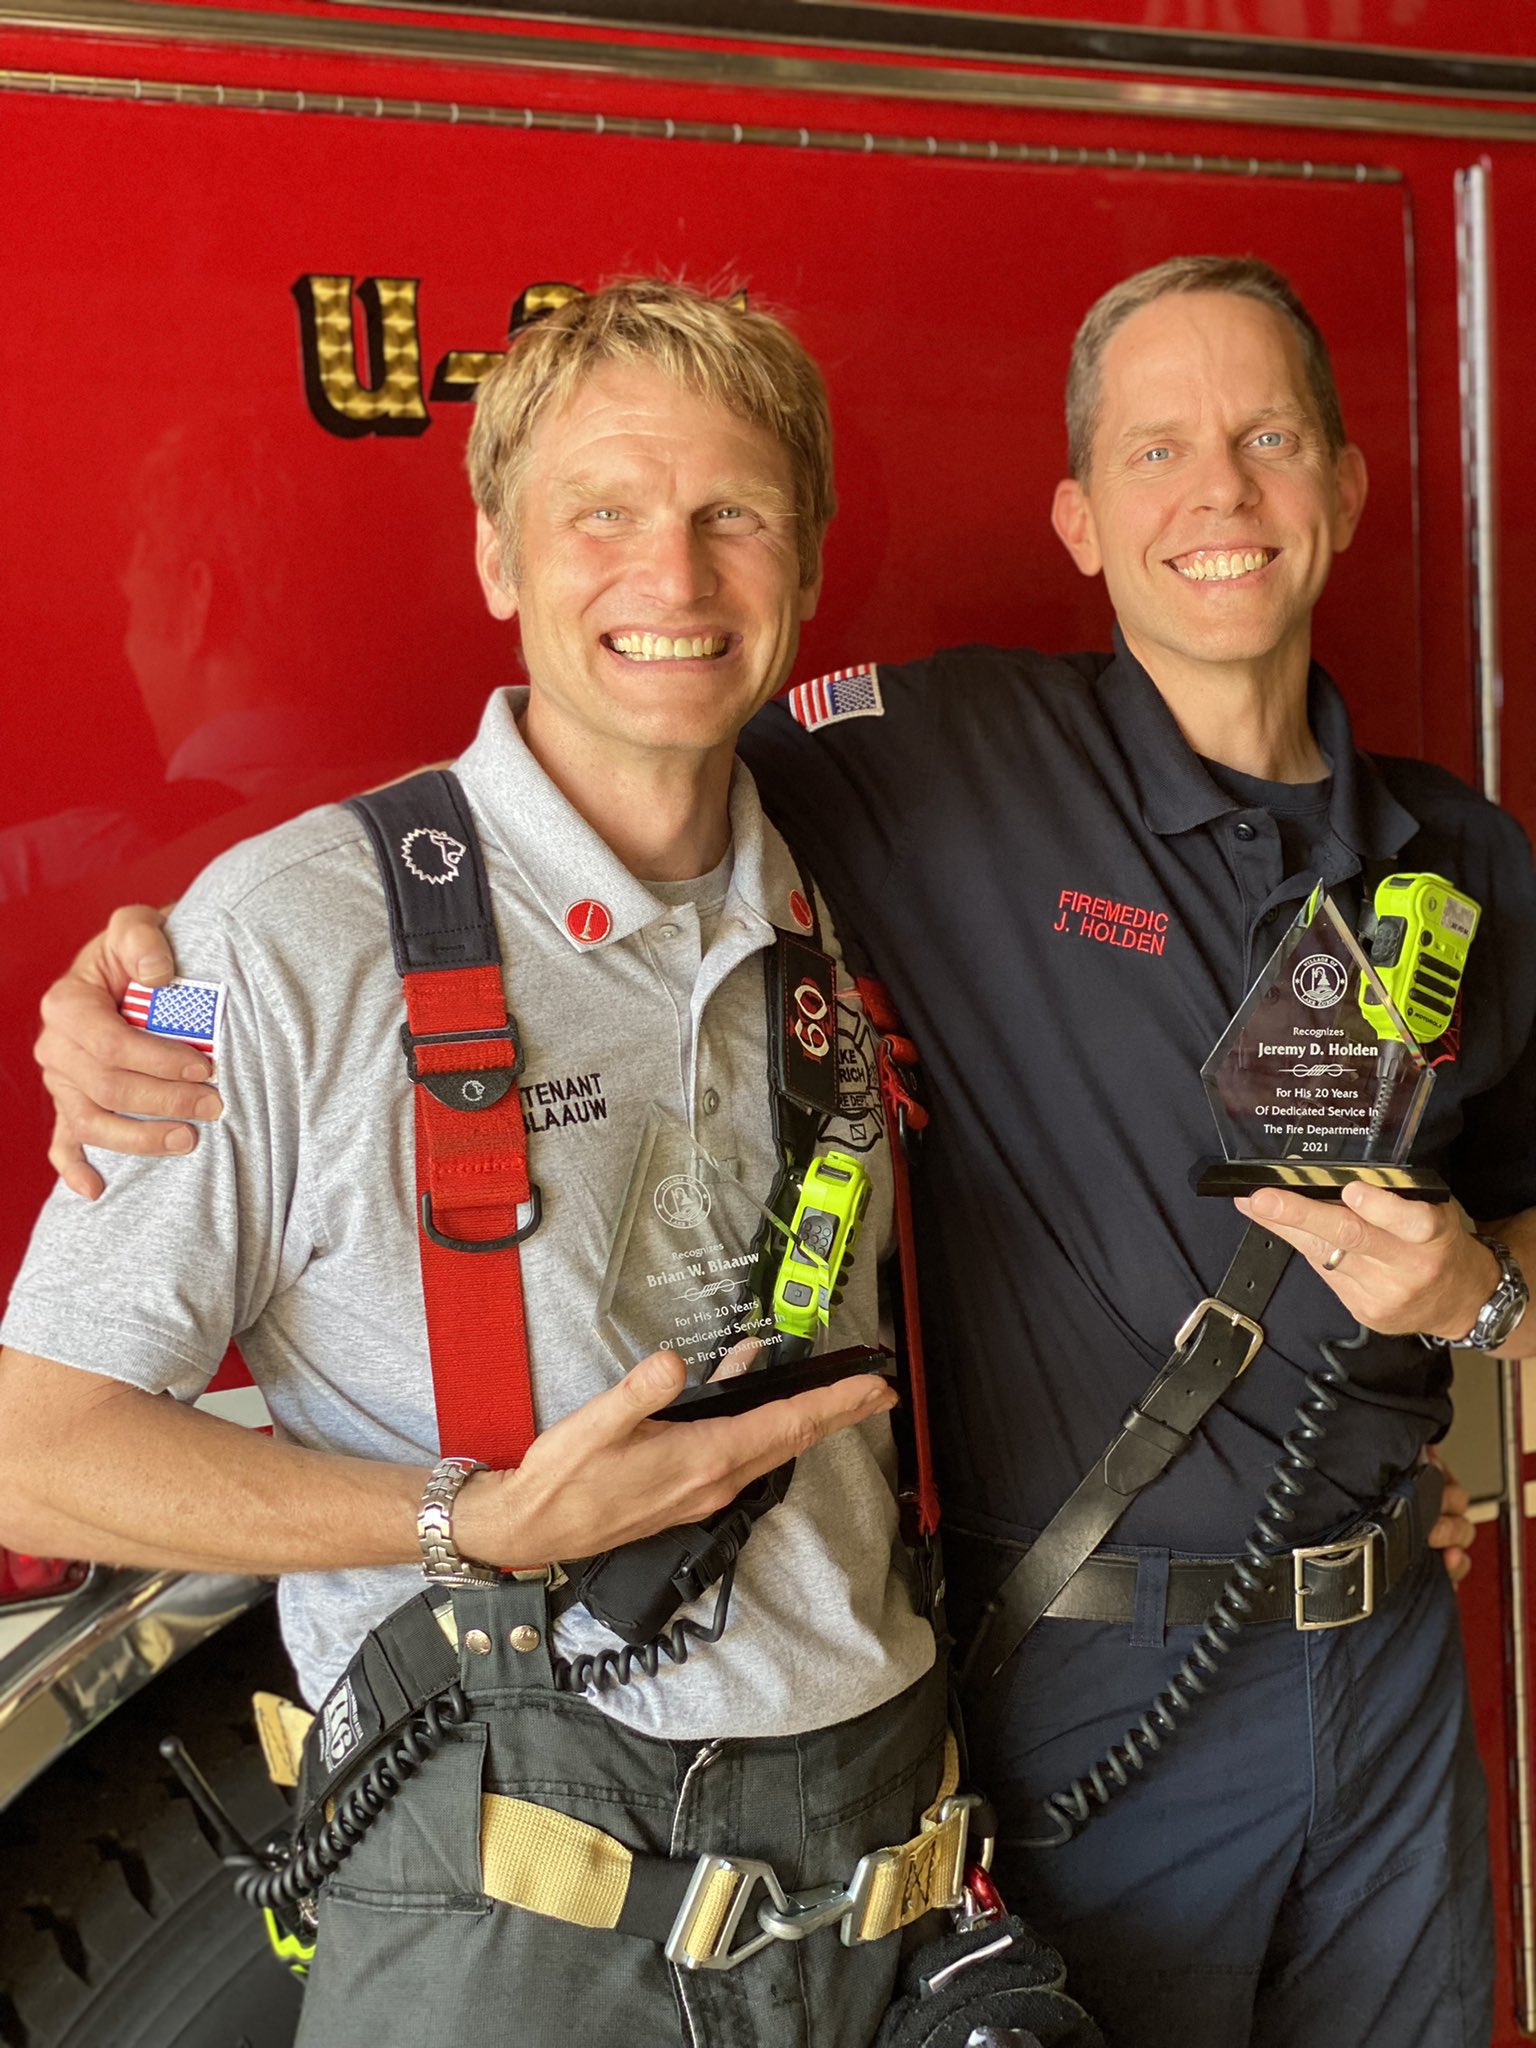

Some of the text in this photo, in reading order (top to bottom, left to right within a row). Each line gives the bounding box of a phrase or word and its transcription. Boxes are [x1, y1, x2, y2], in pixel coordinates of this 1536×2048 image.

[1058, 889, 1169, 933] FIREMEDIC
[1053, 911, 1166, 956] J. HOLDEN
[1293, 1027, 1345, 1038] Recognizes
[1258, 1042, 1379, 1058] Jeremy D. Holden
[1276, 1087, 1359, 1099] For His 20 Years
[1255, 1105, 1379, 1117] Of Dedicated Service In
[1264, 1124, 1370, 1136] The Fire Department
[1302, 1142, 1328, 1152] 2021
[671, 1243, 724, 1261] Recognizes
[646, 1252, 760, 1288] Brian W. Blaauw
[675, 1300, 759, 1327] For His 20 Years
[659, 1313, 786, 1351] Of Dedicated Service In
[697, 1349, 717, 1363] Fire
[718, 1333, 783, 1357] Department
